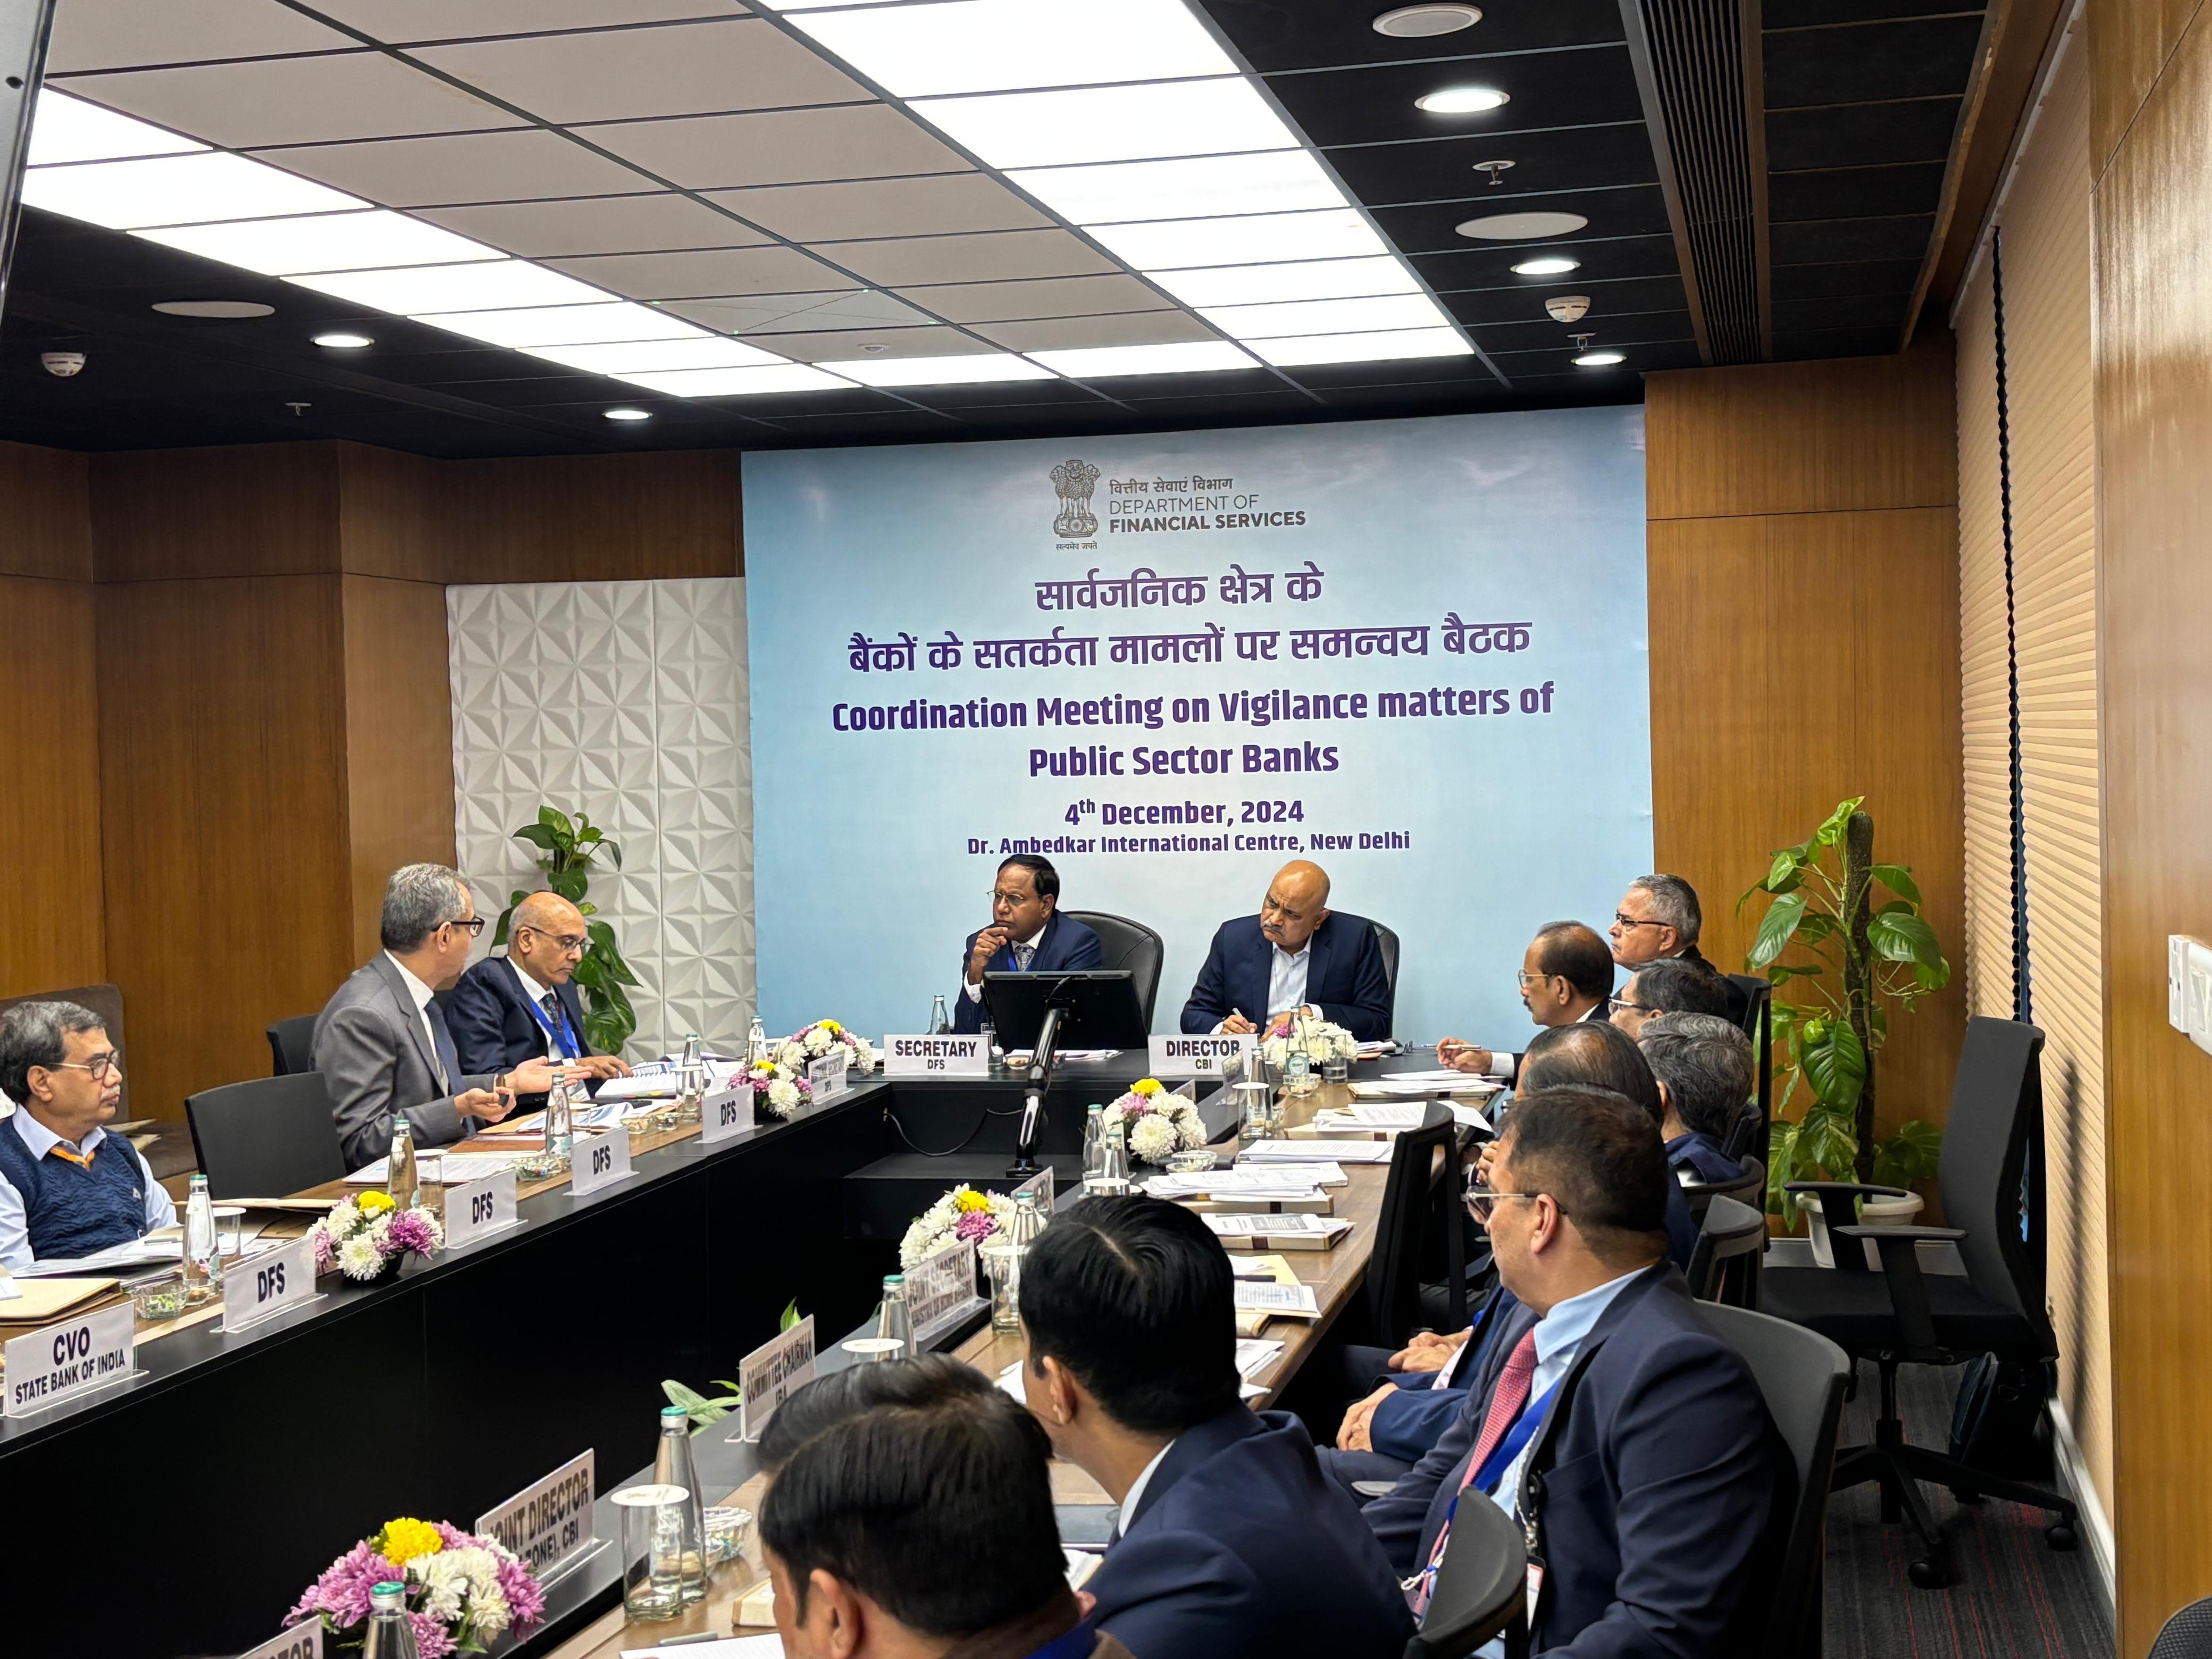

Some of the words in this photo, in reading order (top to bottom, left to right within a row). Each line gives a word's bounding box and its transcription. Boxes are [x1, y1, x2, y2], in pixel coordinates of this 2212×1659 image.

[1109, 479, 1149, 495] वित्तीय
[1153, 476, 1188, 492] सेवाएं
[1192, 475, 1233, 491] विभाग
[1110, 496, 1229, 514] DEPARTMENT
[1234, 495, 1259, 509] OF
[1110, 515, 1210, 533] FINANCIAL
[1216, 511, 1306, 529] SERVICES
[1035, 568, 1208, 610] सार्वजनिक
[1220, 564, 1274, 604] क्षेत्र
[1285, 561, 1324, 601] के
[848, 632, 918, 672] बैंकों
[927, 631, 963, 669] के
[973, 626, 1099, 668] सतर्कता
[1109, 622, 1225, 664] मामलों
[1235, 631, 1280, 660] पर
[1289, 626, 1430, 659] समन्वय
[833, 697, 1026, 731] Coordination
[1037, 693, 1163, 729] Meeting
[1172, 698, 1209, 723] on
[1219, 690, 1367, 726] Vigilance
[1378, 687, 1510, 717] matters
[1520, 681, 1554, 714] of
[1030, 745, 1124, 777] Public
[1133, 746, 1233, 775] Sector
[1243, 741, 1338, 773] Banks
[1065, 799, 1095, 825] 4th
[1102, 801, 1233, 827] December,
[1242, 800, 1304, 823] 2024
[968, 839, 994, 854] Dr.
[1000, 836, 1095, 854] Ambedkar
[1102, 834, 1228, 852] International
[1235, 835, 1304, 853] Centre,
[1311, 834, 1353, 850] New
[1359, 831, 1409, 849] Delhi
[895, 1040, 977, 1057] SECRETARY
[1166, 1040, 1241, 1057] DIRECTOR
[927, 1059, 945, 1070] DFS
[1195, 1059, 1212, 1069] CBI
[720, 1101, 736, 1126] DFS
[593, 1145, 610, 1175] DFS
[472, 1191, 493, 1224] DFS
[257, 1262, 286, 1303] DFS
[53, 1327, 90, 1365] CVO
[15, 1375, 48, 1404] STATE
[51, 1364, 79, 1392] BANK
[81, 1359, 95, 1380] OF
[98, 1348, 125, 1375] INDIA
[529, 1468, 588, 1540] DIRECTOR
[562, 1518, 579, 1550] CBI
